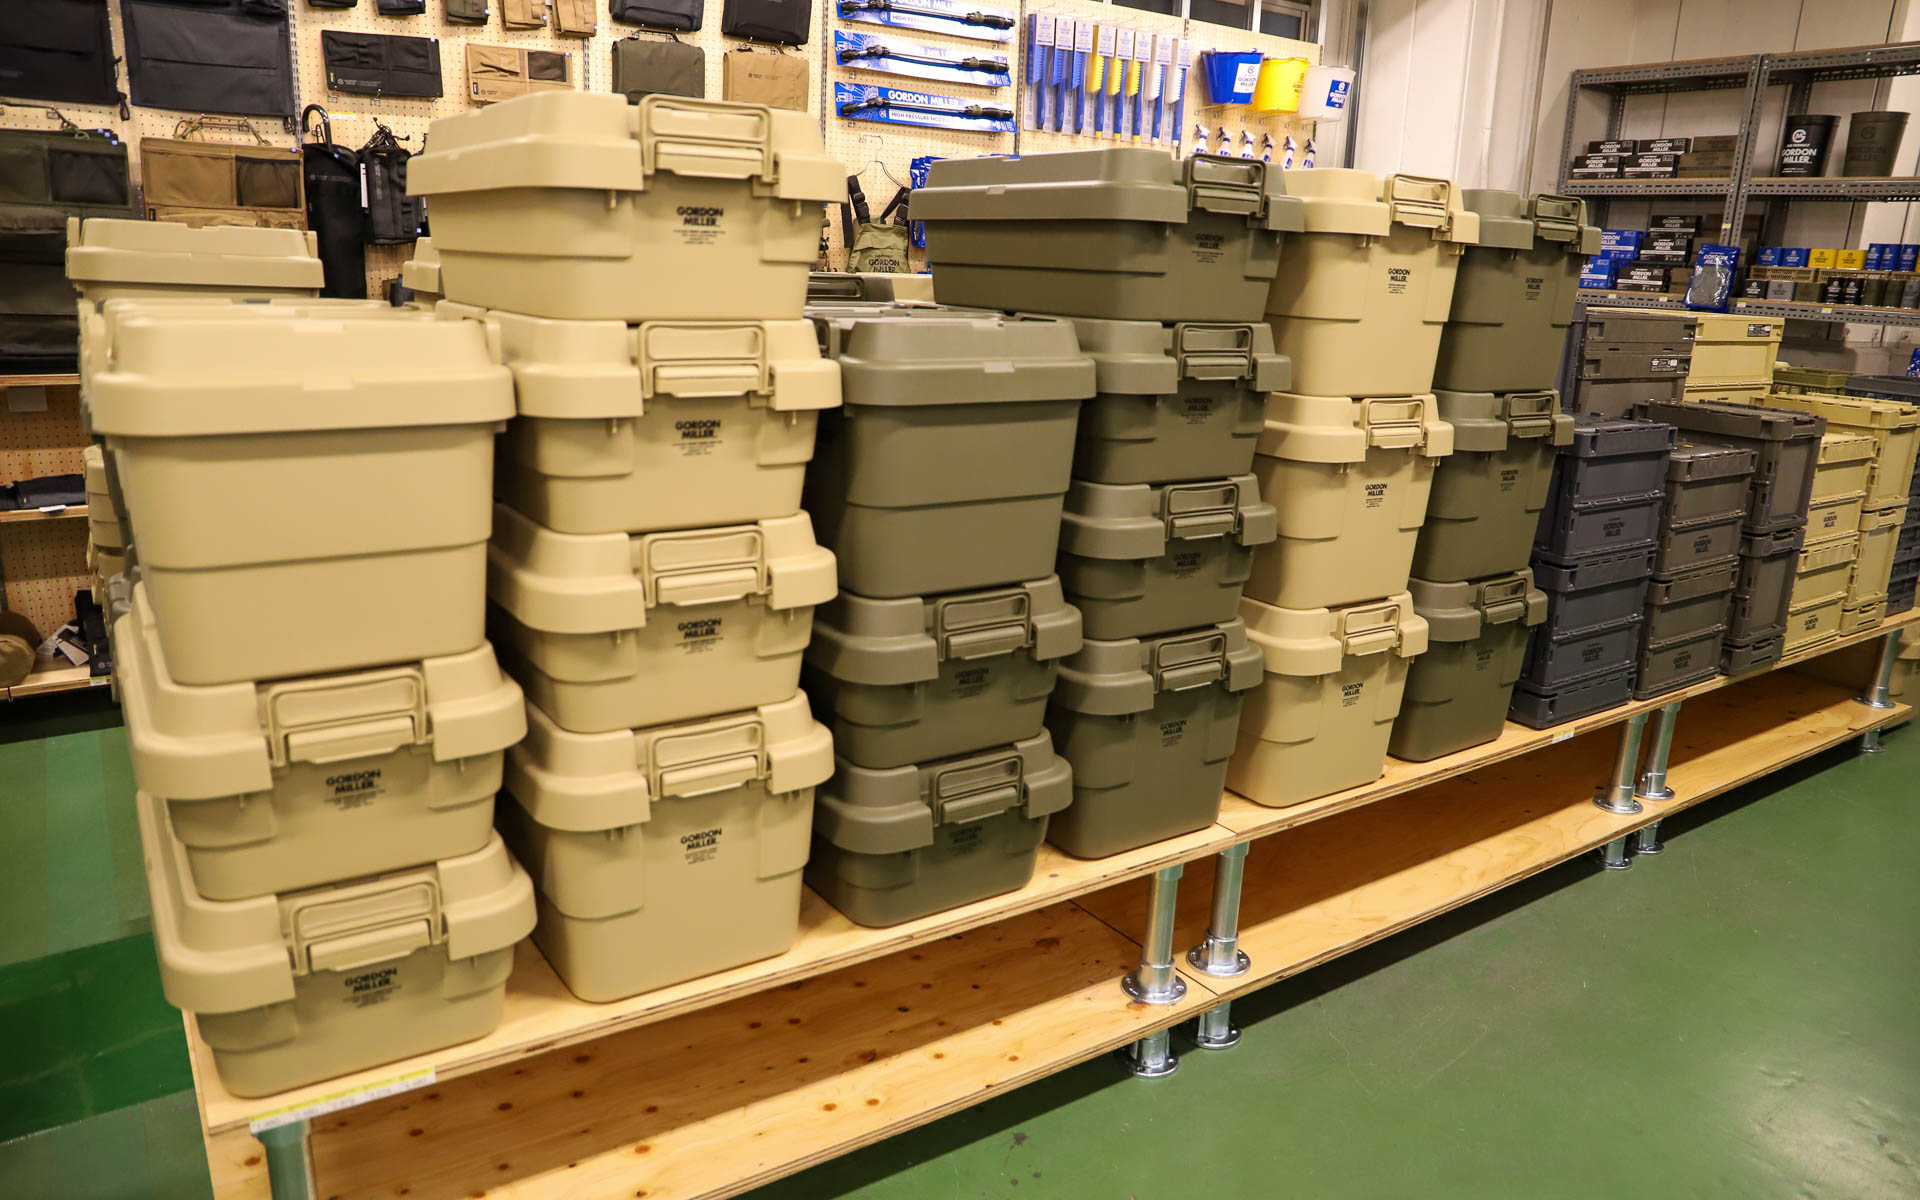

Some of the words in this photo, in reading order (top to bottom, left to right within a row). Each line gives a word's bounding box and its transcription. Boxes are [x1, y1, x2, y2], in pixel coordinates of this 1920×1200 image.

[888, 90, 928, 105] GORDON
[930, 96, 959, 107] MILLER
[1783, 156, 1811, 164] MILLER
[676, 206, 724, 216] GORDON
[683, 217, 717, 227] MILLER
[1195, 233, 1225, 243] GORDON
[868, 258, 900, 267] GORDON
[675, 420, 721, 430] GORDON
[681, 429, 715, 439] MILLER
[1365, 483, 1388, 491] GORDON
[1367, 489, 1385, 497] MILLER
[678, 617, 722, 632] GORDON
[683, 628, 717, 640] MILLER
[1341, 682, 1364, 692] GORDON
[1344, 688, 1361, 698] MILLER
[1160, 719, 1188, 731] GORDON
[325, 769, 382, 787] GORDON
[335, 780, 376, 795] MILLER
[680, 828, 723, 844] GORDON
[686, 837, 718, 851] MILLER
[344, 967, 398, 987] GORDON
[352, 978, 393, 994] MILLER
